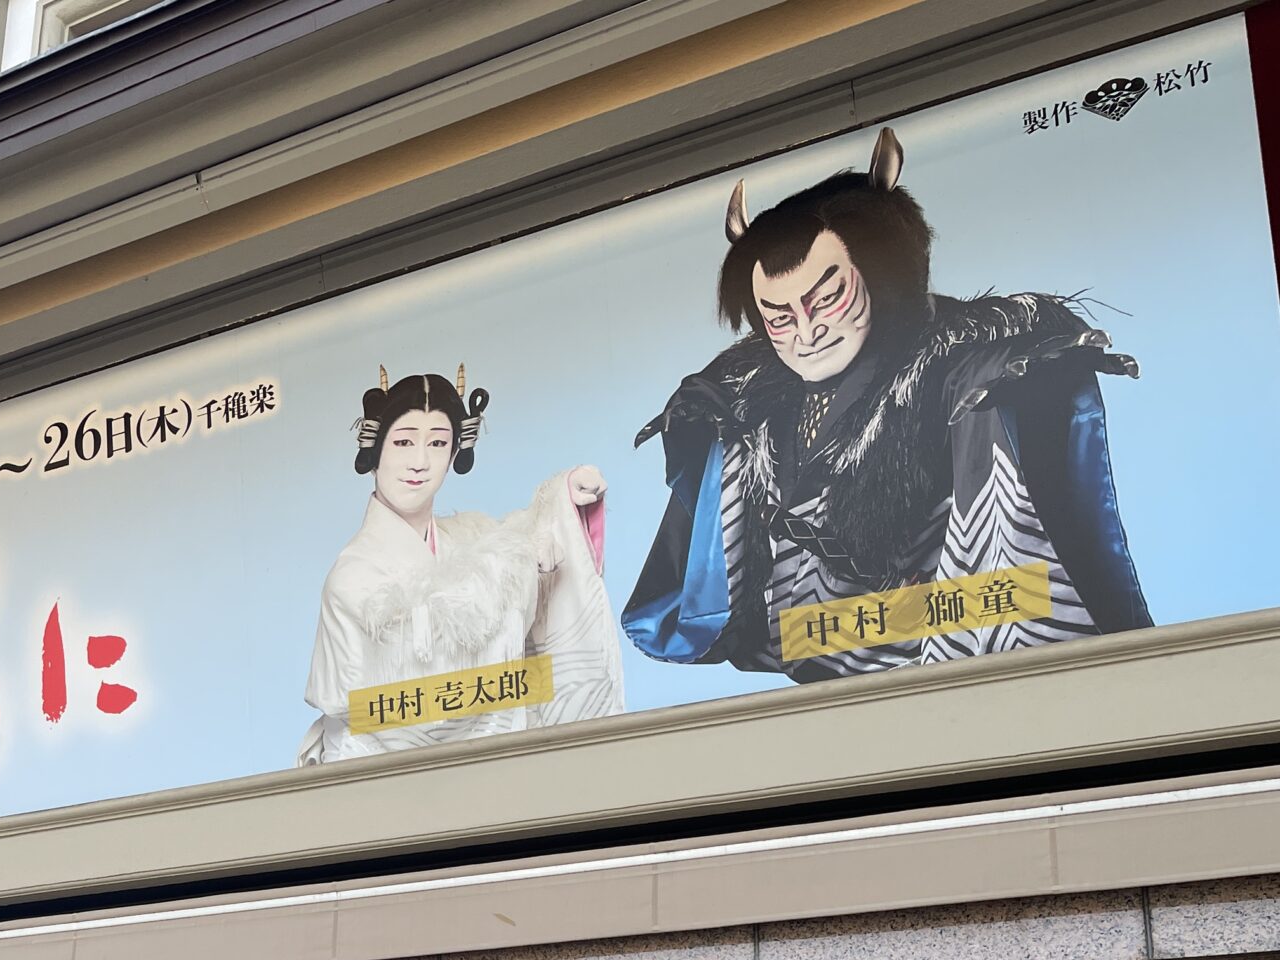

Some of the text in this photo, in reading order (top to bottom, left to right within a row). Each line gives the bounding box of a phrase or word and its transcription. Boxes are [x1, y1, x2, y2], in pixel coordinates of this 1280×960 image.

[1021, 60, 1213, 135] 製作 松竹
[805, 580, 1020, 647] 中村 獅童
[368, 671, 529, 726] 中村 壱太郎
